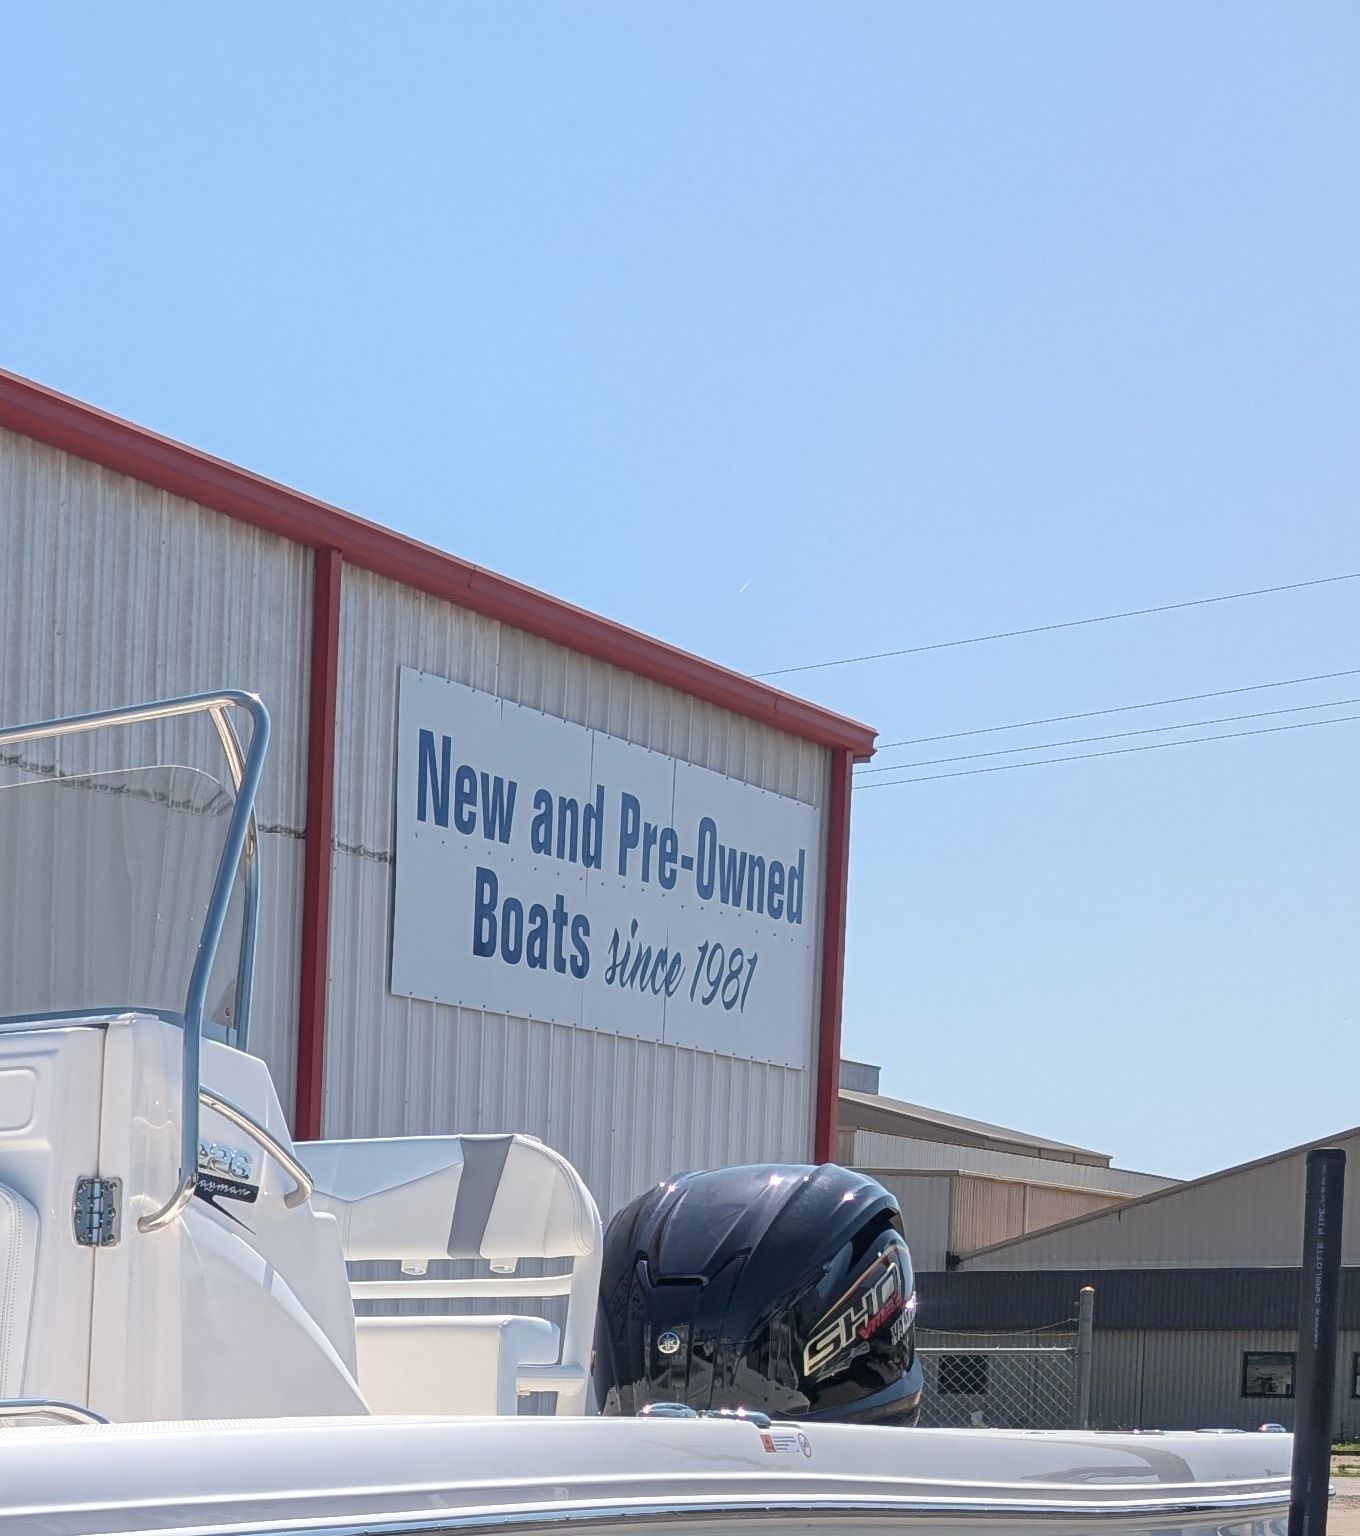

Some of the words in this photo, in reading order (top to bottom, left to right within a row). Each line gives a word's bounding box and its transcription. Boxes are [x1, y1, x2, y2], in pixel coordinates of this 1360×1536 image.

[417, 728, 518, 845] New
[531, 783, 605, 870] and
[618, 792, 806, 925] Pre-Owned
[472, 866, 591, 979] Boats
[604, 918, 687, 999] since
[689, 940, 758, 1014] 1981
[803, 1262, 902, 1377] SHO
